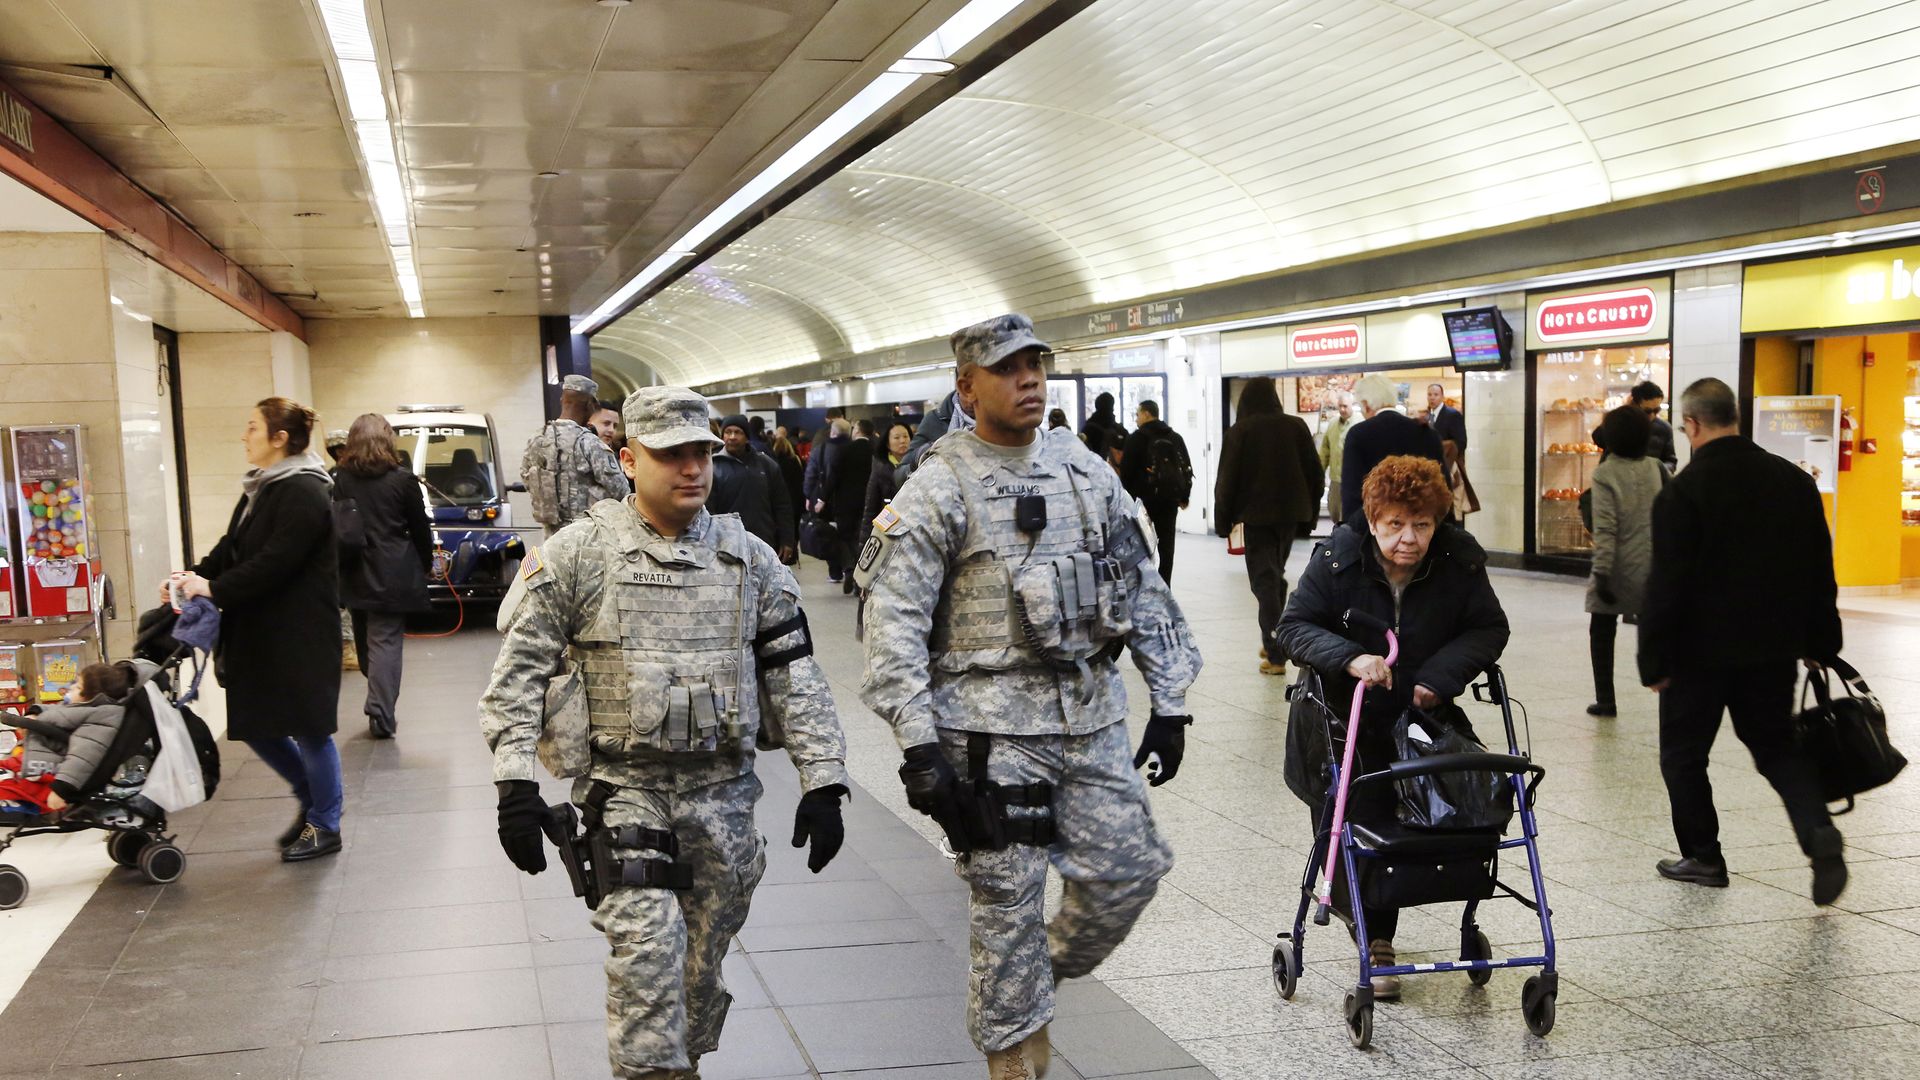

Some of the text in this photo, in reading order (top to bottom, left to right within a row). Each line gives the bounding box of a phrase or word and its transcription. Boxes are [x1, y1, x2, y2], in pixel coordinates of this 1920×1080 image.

[399, 427, 465, 437] POLICE
[996, 484, 1040, 495] WILLIAMS
[633, 572, 673, 584] REVATTA
